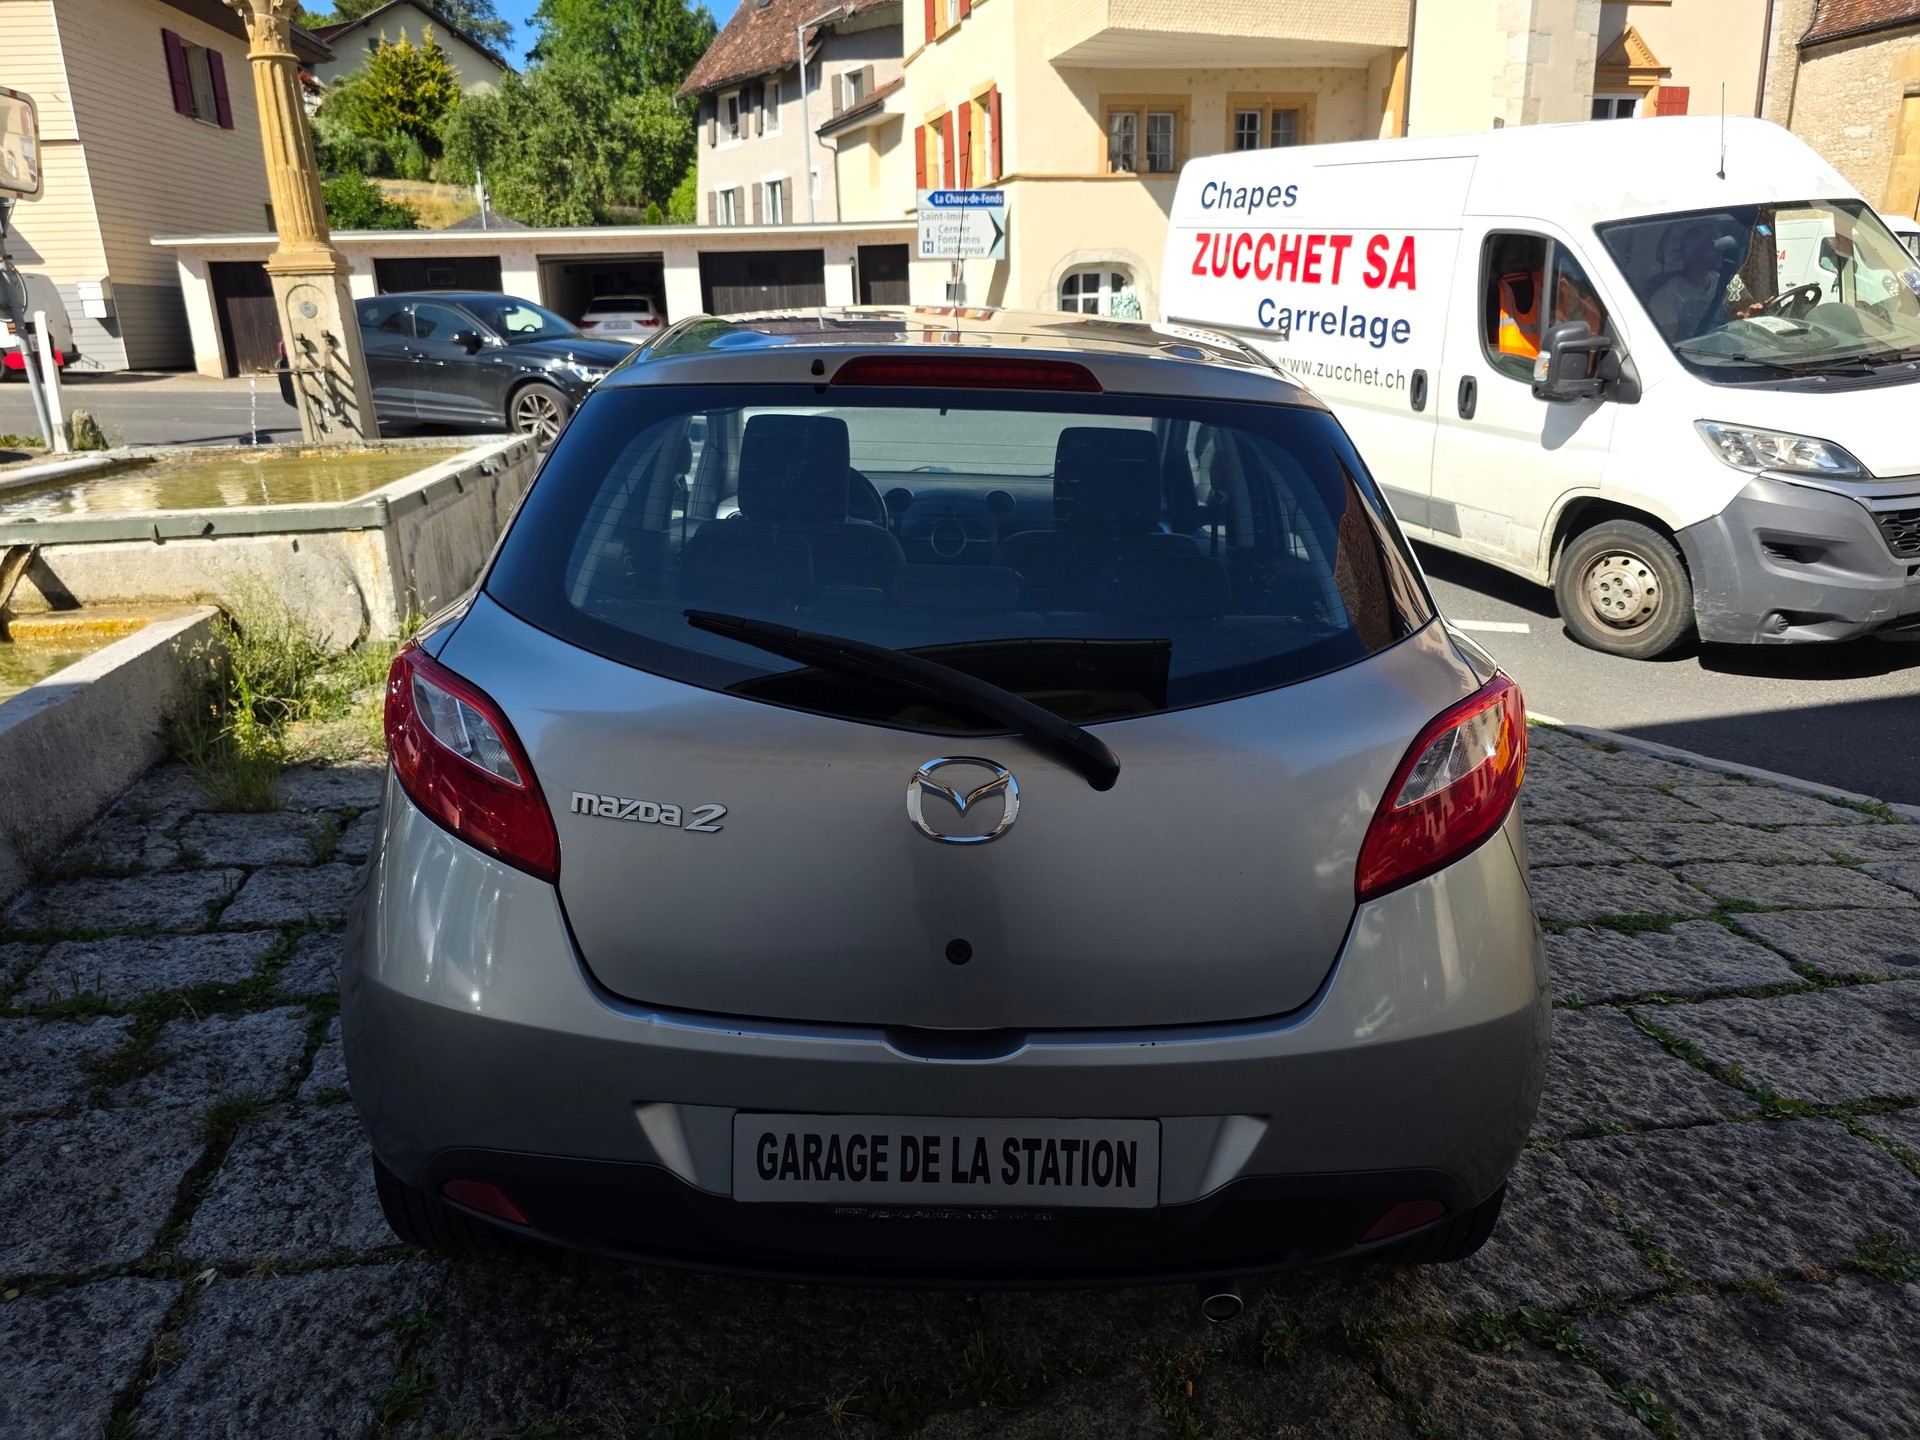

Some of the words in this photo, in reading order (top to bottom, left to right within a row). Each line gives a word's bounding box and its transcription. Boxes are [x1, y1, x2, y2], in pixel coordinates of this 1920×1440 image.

[935, 194, 944, 204] La
[945, 193, 1003, 204] Chaux-de-Fonds
[1201, 181, 1299, 215] Chapes
[938, 225, 970, 233] Cerner
[1191, 232, 1353, 285] ZUCCHET
[1362, 234, 1417, 291] SA
[1258, 298, 1411, 349] Carrelage
[1278, 356, 1405, 391] www.zucchet.ch
[684, 803, 728, 833] 2
[756, 1132, 889, 1182] GARAGE
[900, 1135, 941, 1184] DE
[951, 1136, 991, 1184] LA
[1001, 1137, 1137, 1188] STATION
